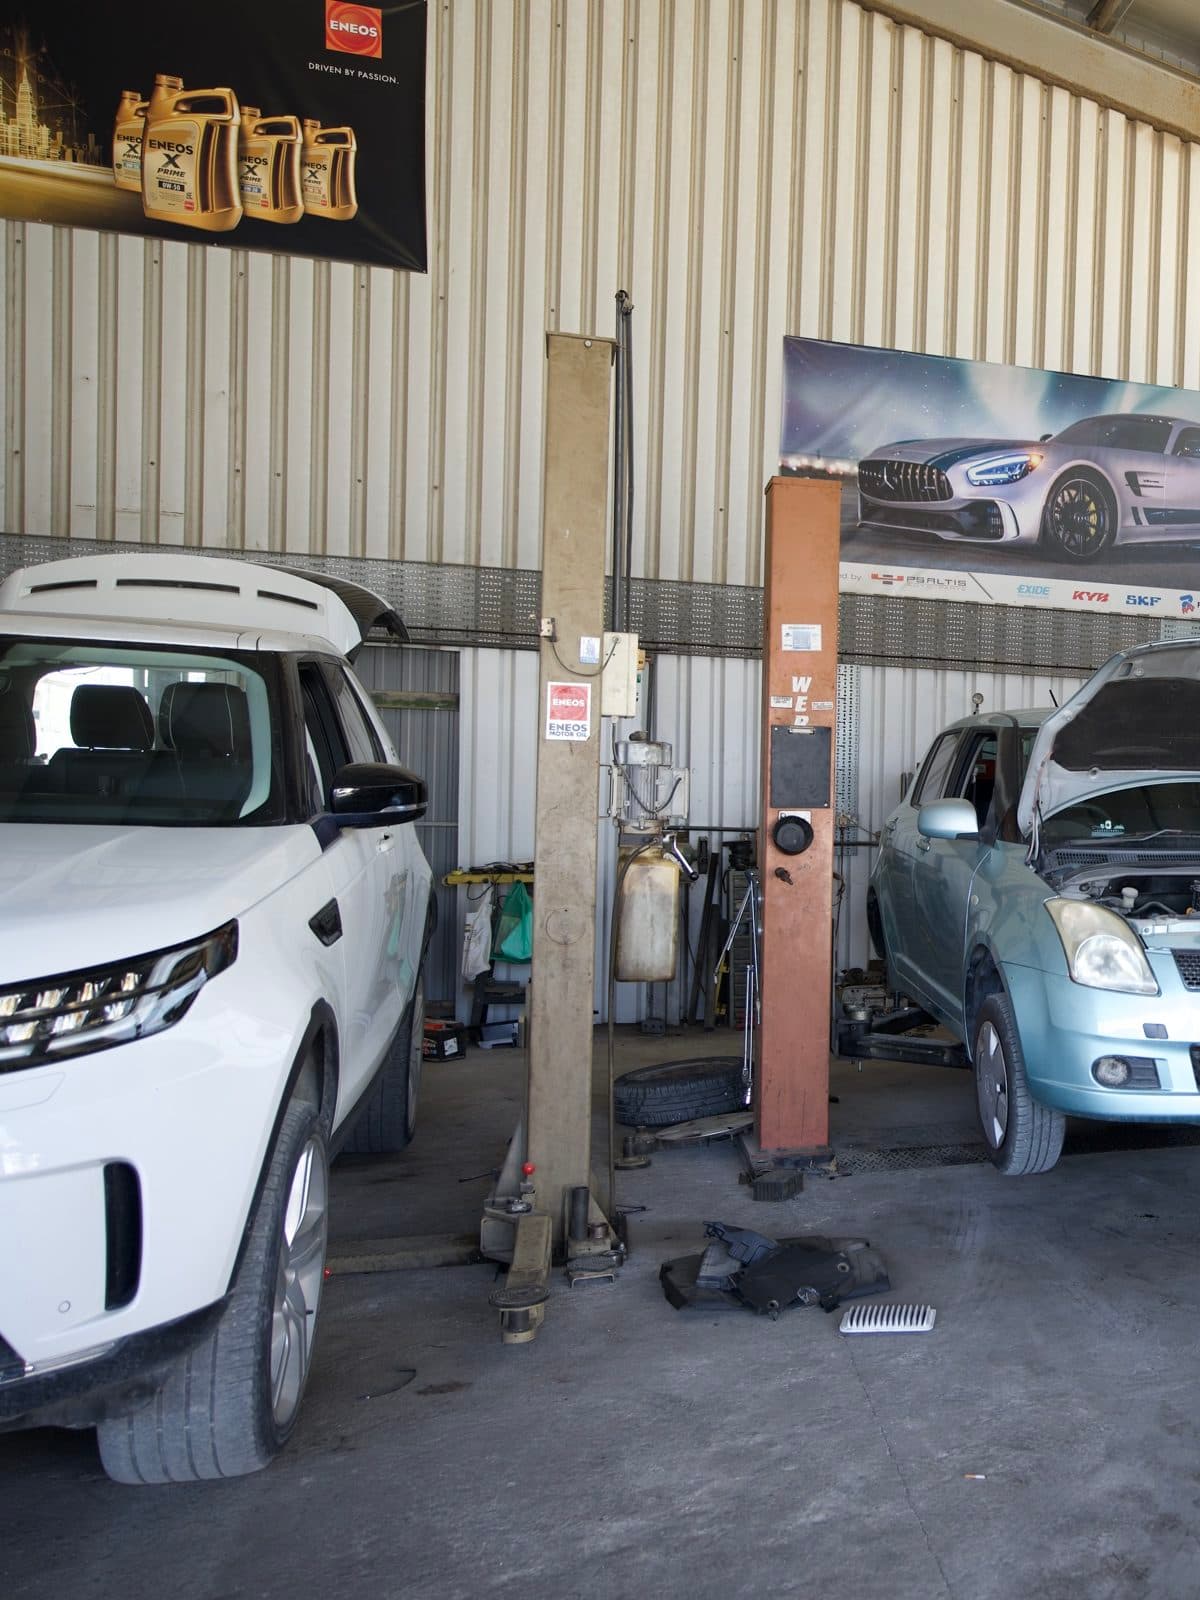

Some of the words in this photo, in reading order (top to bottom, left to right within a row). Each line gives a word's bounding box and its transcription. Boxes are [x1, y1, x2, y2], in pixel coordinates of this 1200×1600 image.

[329, 20, 378, 38] ENEOS
[308, 62, 342, 75] DRIVEN
[344, 68, 356, 77] BY
[357, 71, 400, 85] PASSION.
[116, 133, 143, 144] ENEO
[126, 143, 139, 154] X
[148, 139, 194, 156] ENEOS
[161, 153, 182, 169] X
[240, 155, 268, 166] NEOS
[303, 162, 328, 171] NEOS
[156, 167, 186, 178] PRIME
[244, 164, 258, 176] X
[307, 169, 320, 180] X
[906, 575, 967, 588] PSALTIS
[1016, 584, 1051, 596] EXIDE
[1073, 590, 1110, 603] KYB
[1126, 595, 1161, 607] SKF
[552, 698, 585, 707] ENEOS
[549, 723, 588, 732] ENEOS
